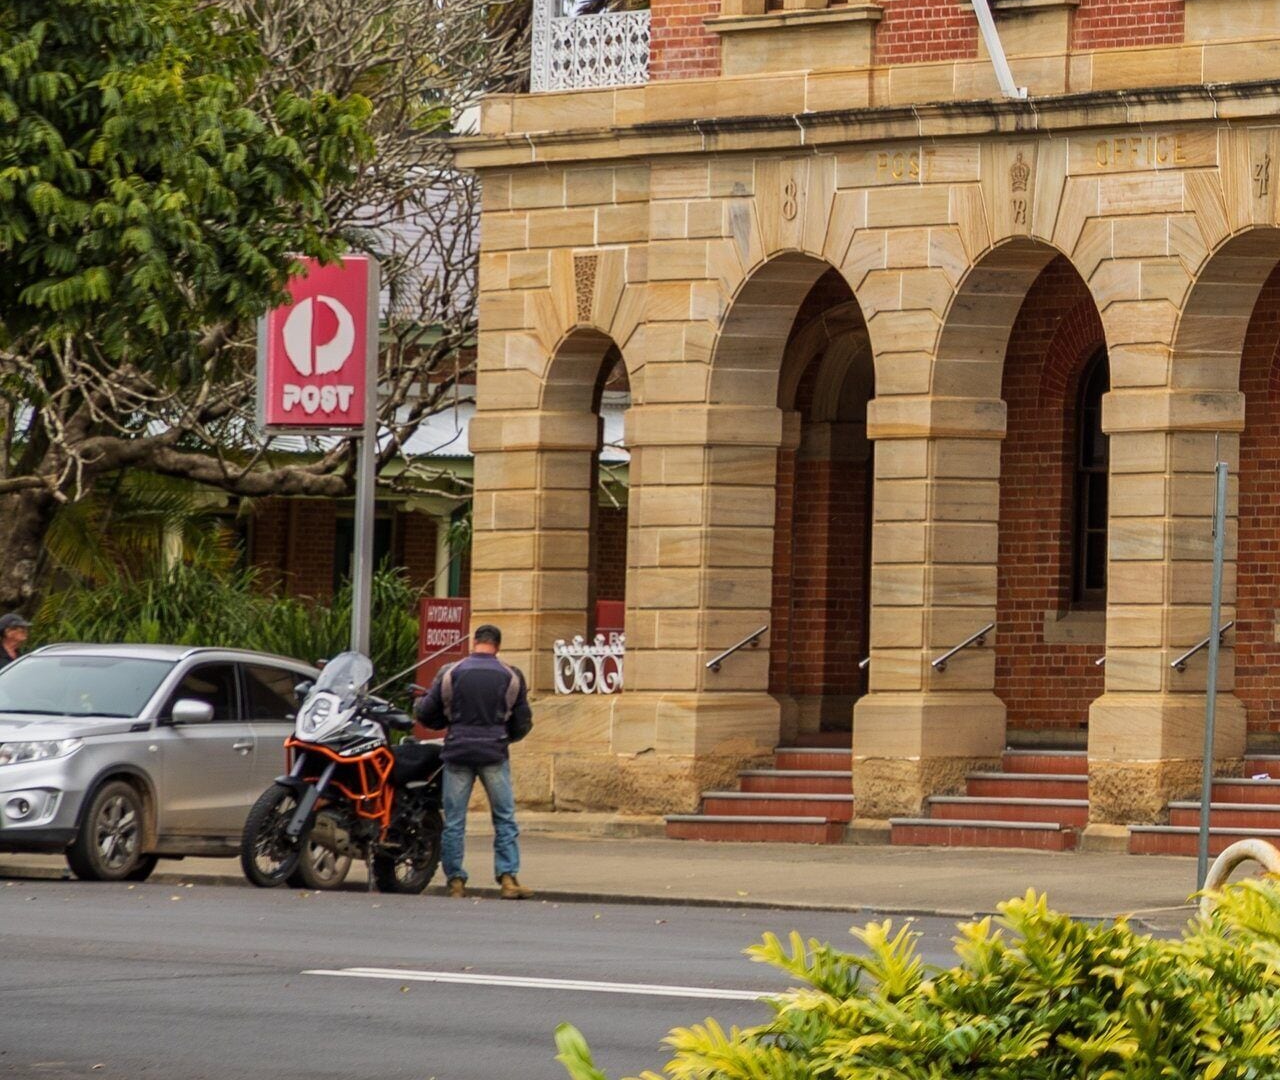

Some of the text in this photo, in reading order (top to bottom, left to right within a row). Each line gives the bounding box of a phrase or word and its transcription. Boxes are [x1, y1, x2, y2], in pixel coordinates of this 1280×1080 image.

[876, 133, 1187, 182] POST OFFICE
[282, 384, 354, 414] POST
[428, 606, 463, 623] HYDRANT
[427, 629, 461, 646] BOOSTER
